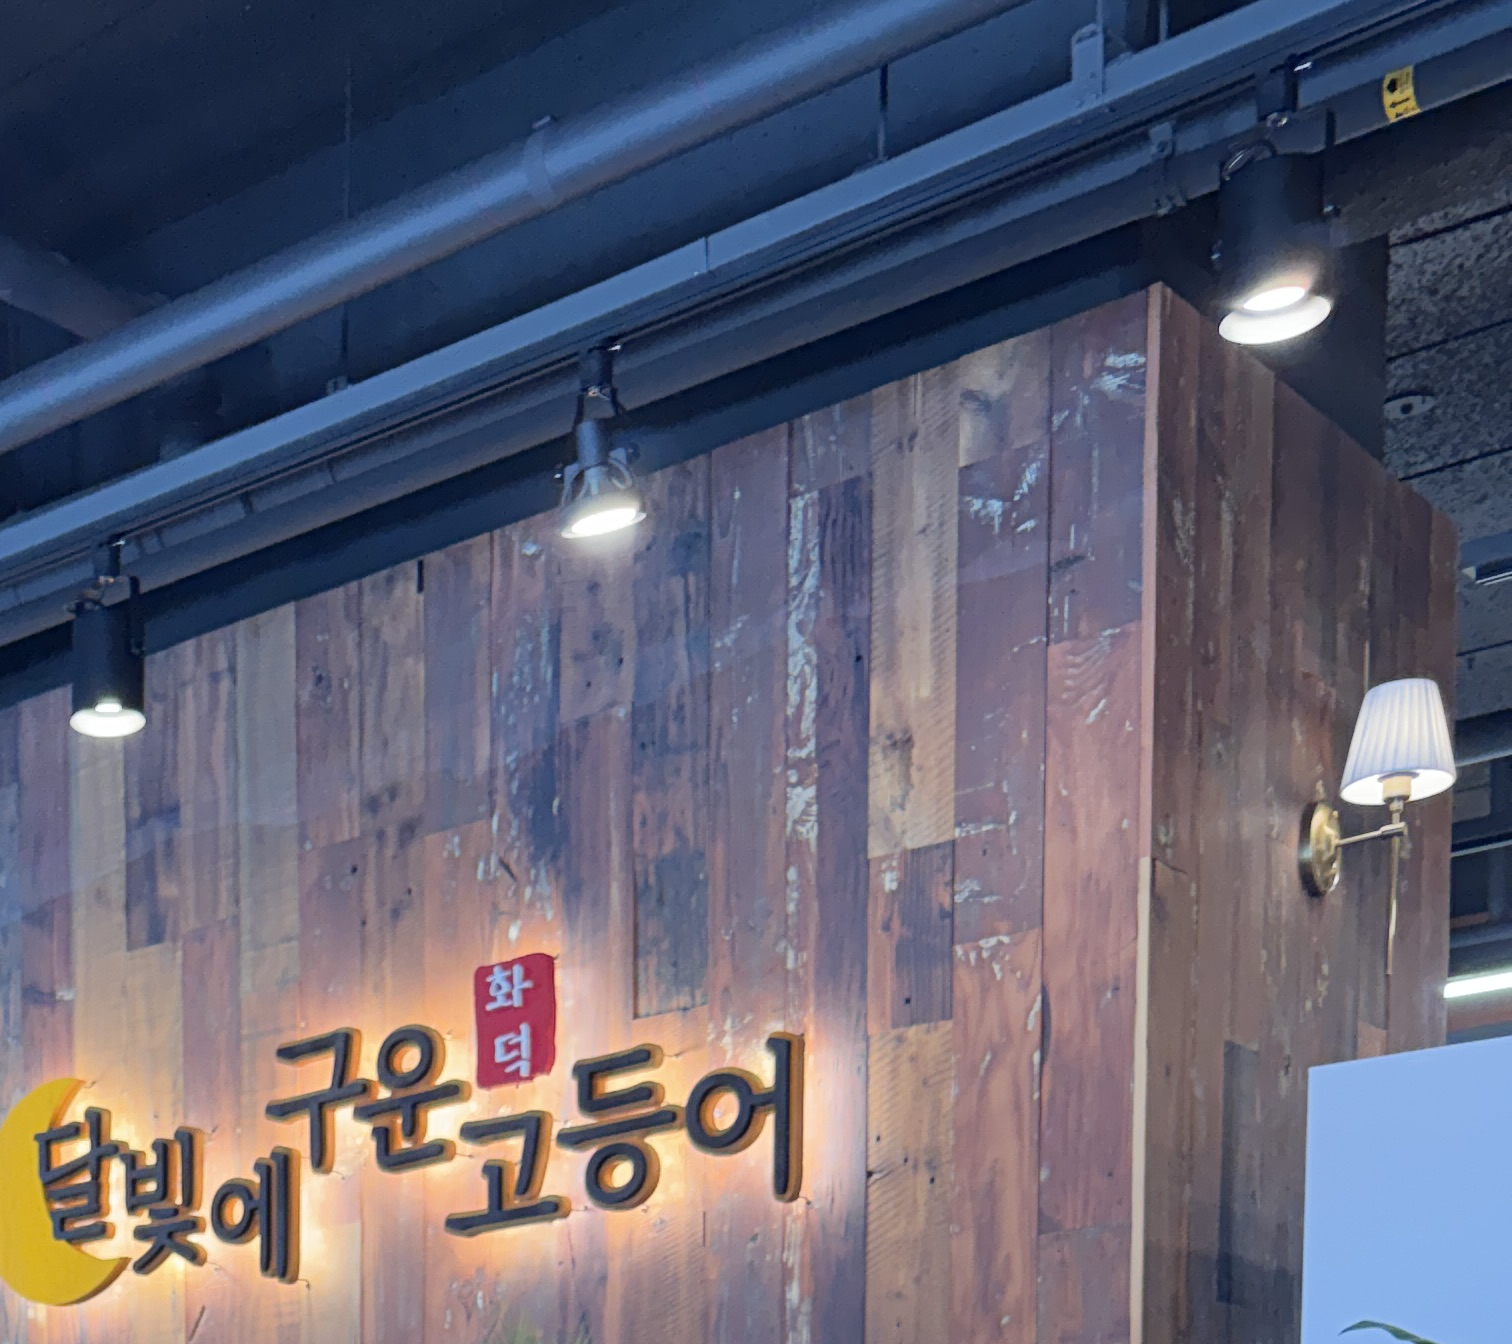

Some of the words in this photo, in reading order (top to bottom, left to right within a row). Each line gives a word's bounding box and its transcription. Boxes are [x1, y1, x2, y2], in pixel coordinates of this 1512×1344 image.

[485, 963, 534, 1077] 화덕
[34, 1106, 300, 1284] 달빛에
[266, 1025, 471, 1172] 구운
[446, 1032, 804, 1236] 고등어
